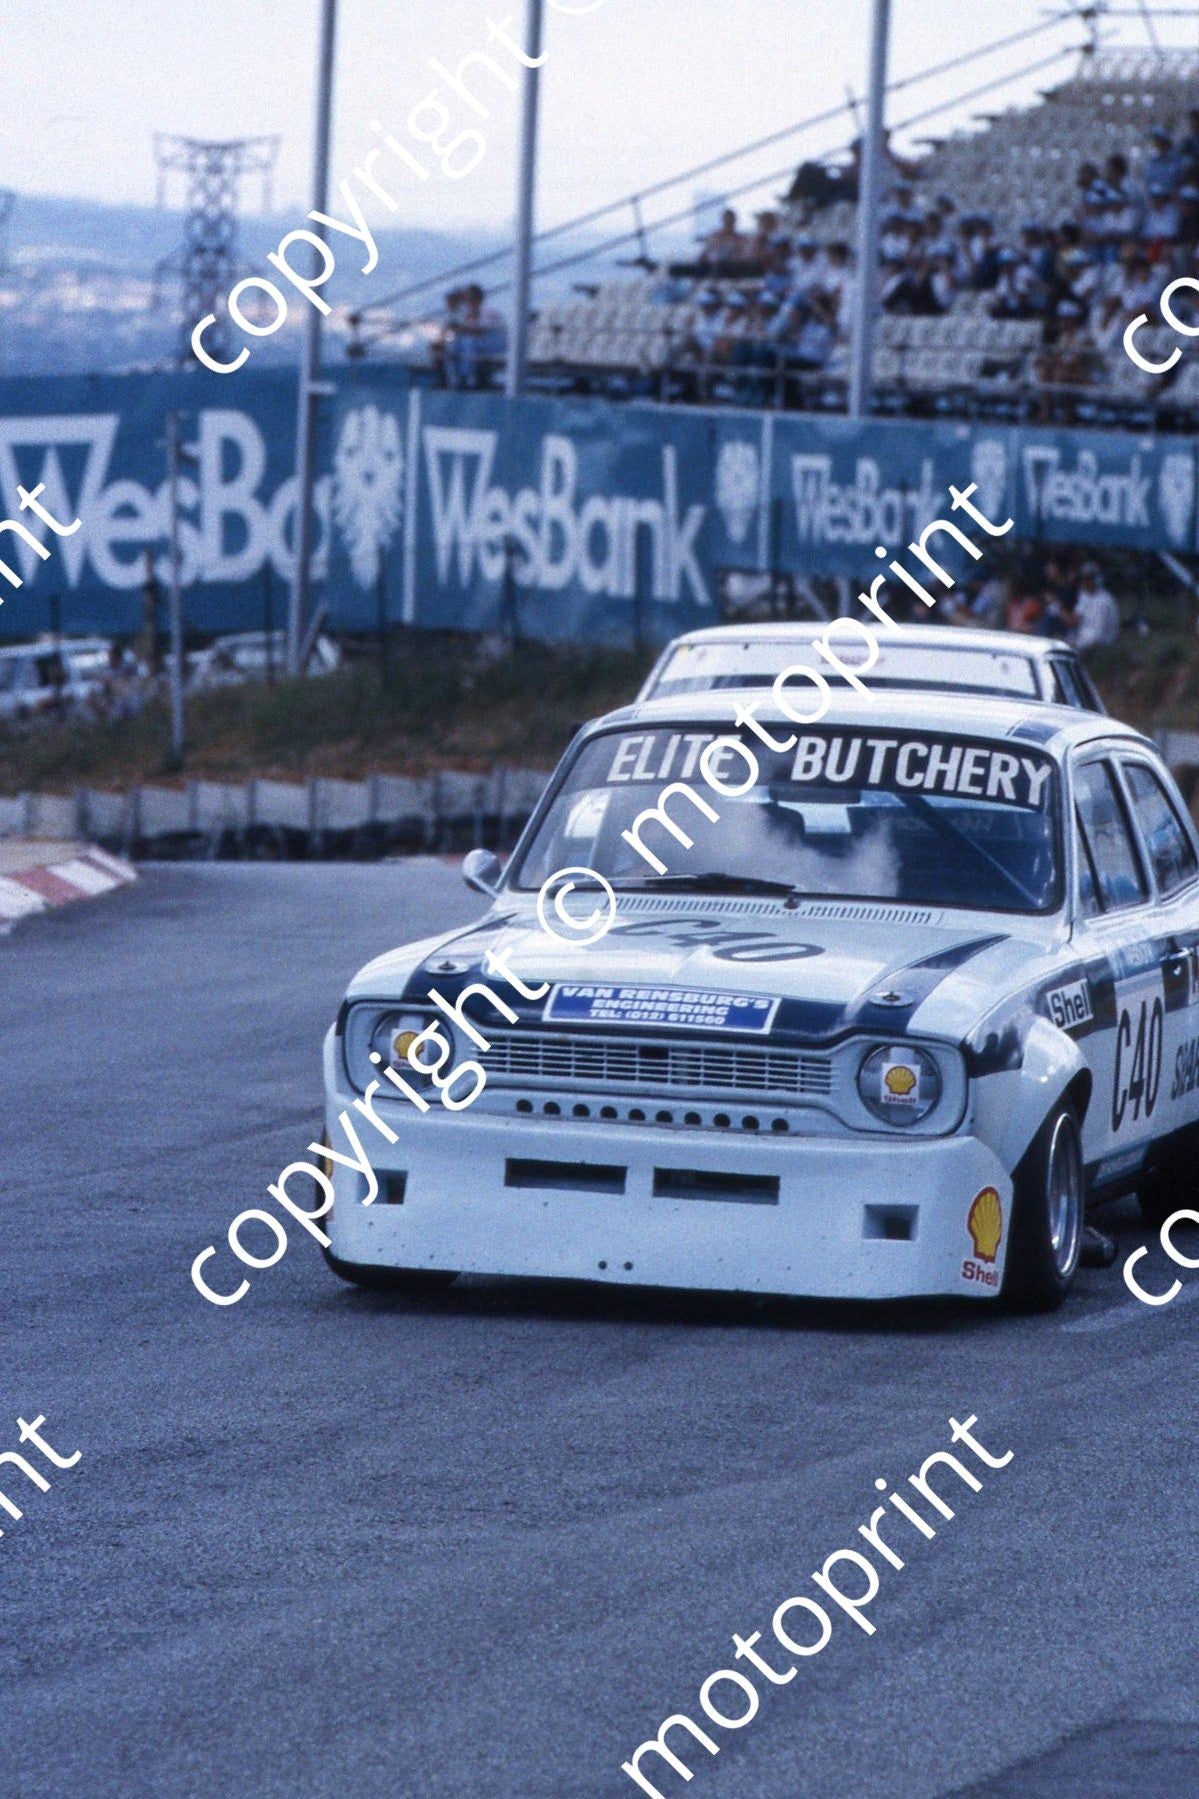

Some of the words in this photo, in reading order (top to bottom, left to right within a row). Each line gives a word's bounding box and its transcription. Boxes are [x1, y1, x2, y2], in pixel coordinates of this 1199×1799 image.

[422, 425, 712, 606] WesBank
[792, 453, 946, 548] WesBank
[1023, 445, 1151, 528] WesBank
[607, 734, 741, 781] ELITE
[791, 736, 1051, 806] BUTCHERY
[561, 987, 614, 998] VAN
[619, 989, 770, 1009] RENSBURG'S
[592, 999, 729, 1016] ENGINEERING
[1111, 996, 1163, 1132] C40
